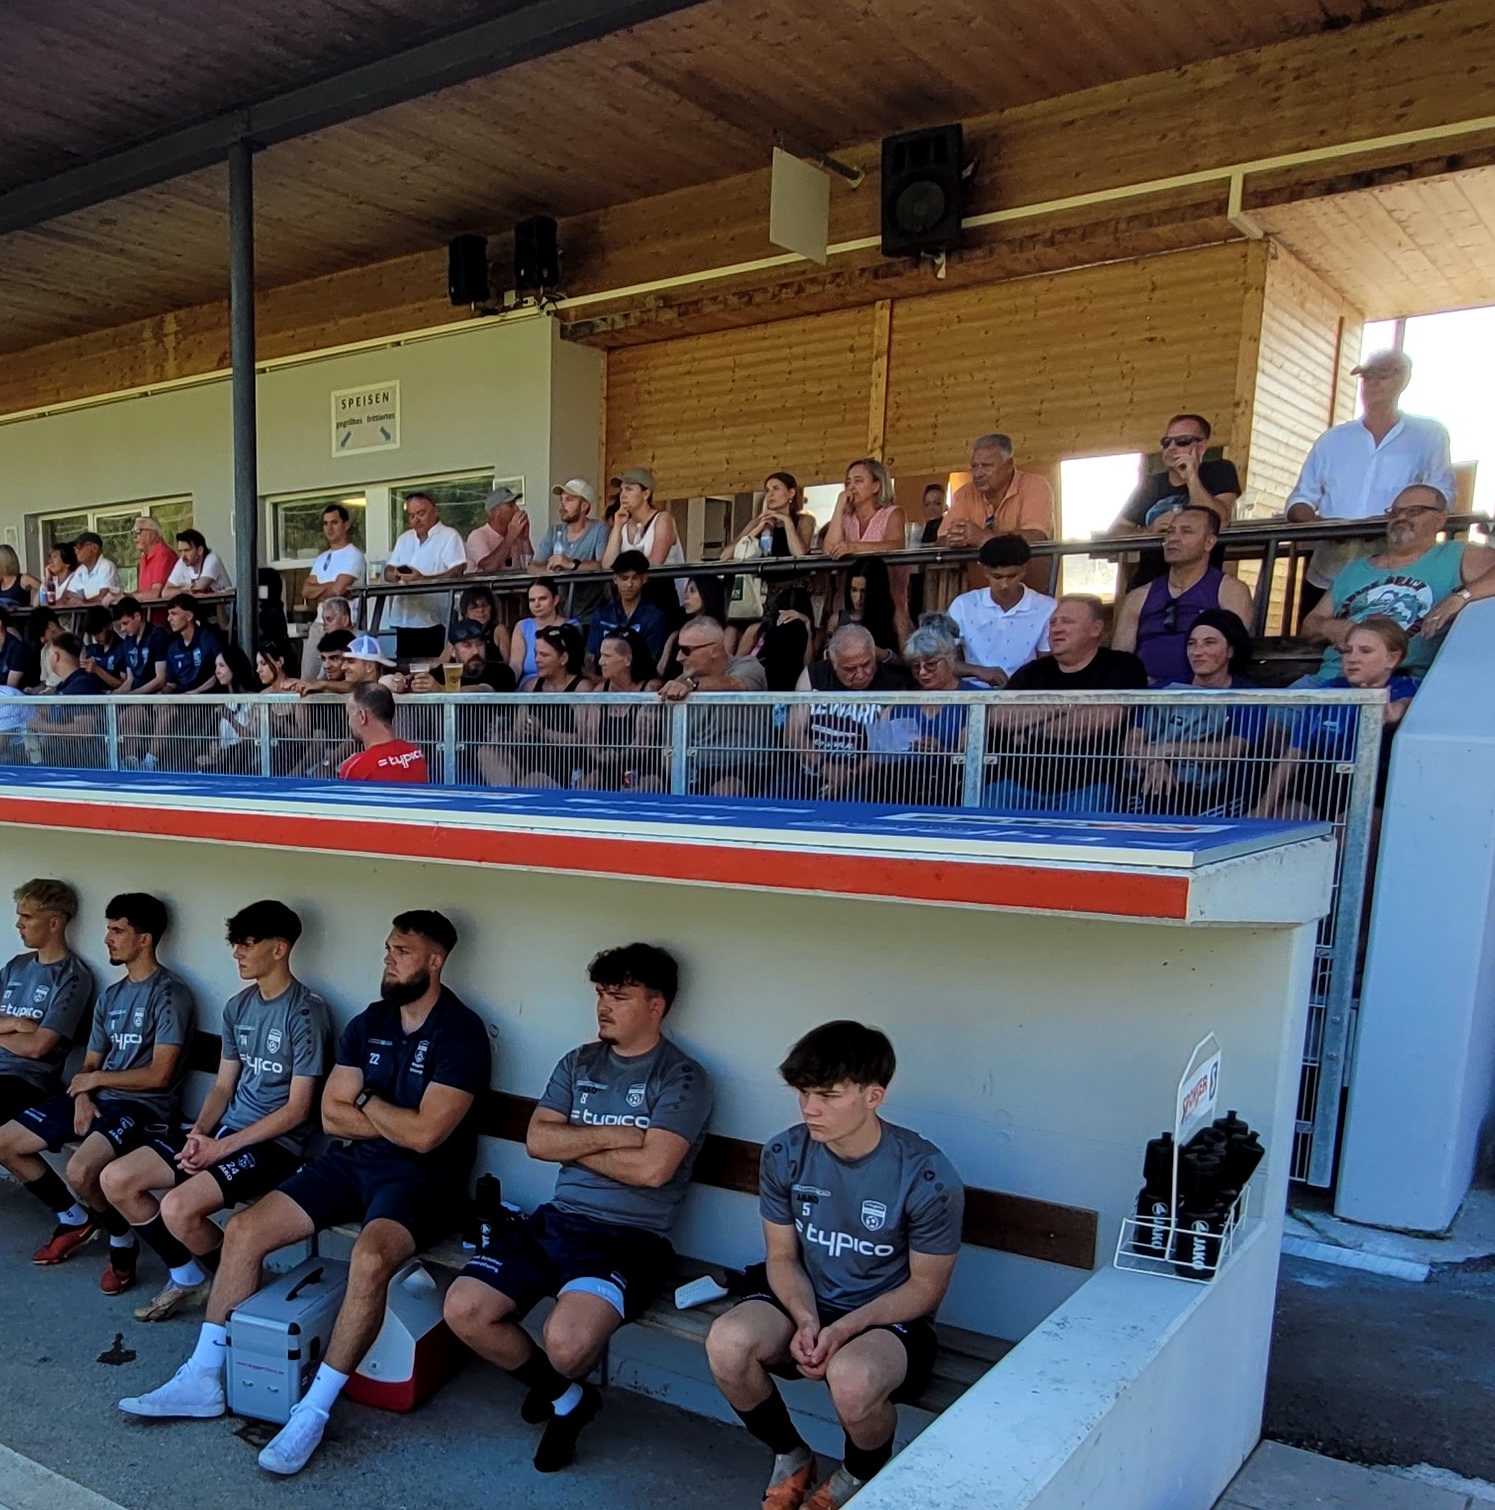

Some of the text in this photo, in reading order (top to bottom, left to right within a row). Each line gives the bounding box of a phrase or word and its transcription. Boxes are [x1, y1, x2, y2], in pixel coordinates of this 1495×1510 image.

[341, 391, 389, 410] SPEISEN
[368, 1052, 381, 1065] 22
[580, 1092, 588, 1104] 8
[226, 1161, 240, 1175] 24
[802, 1202, 811, 1216] 5
[806, 1222, 895, 1257] typico
[1192, 1236, 1206, 1270] JAKO
